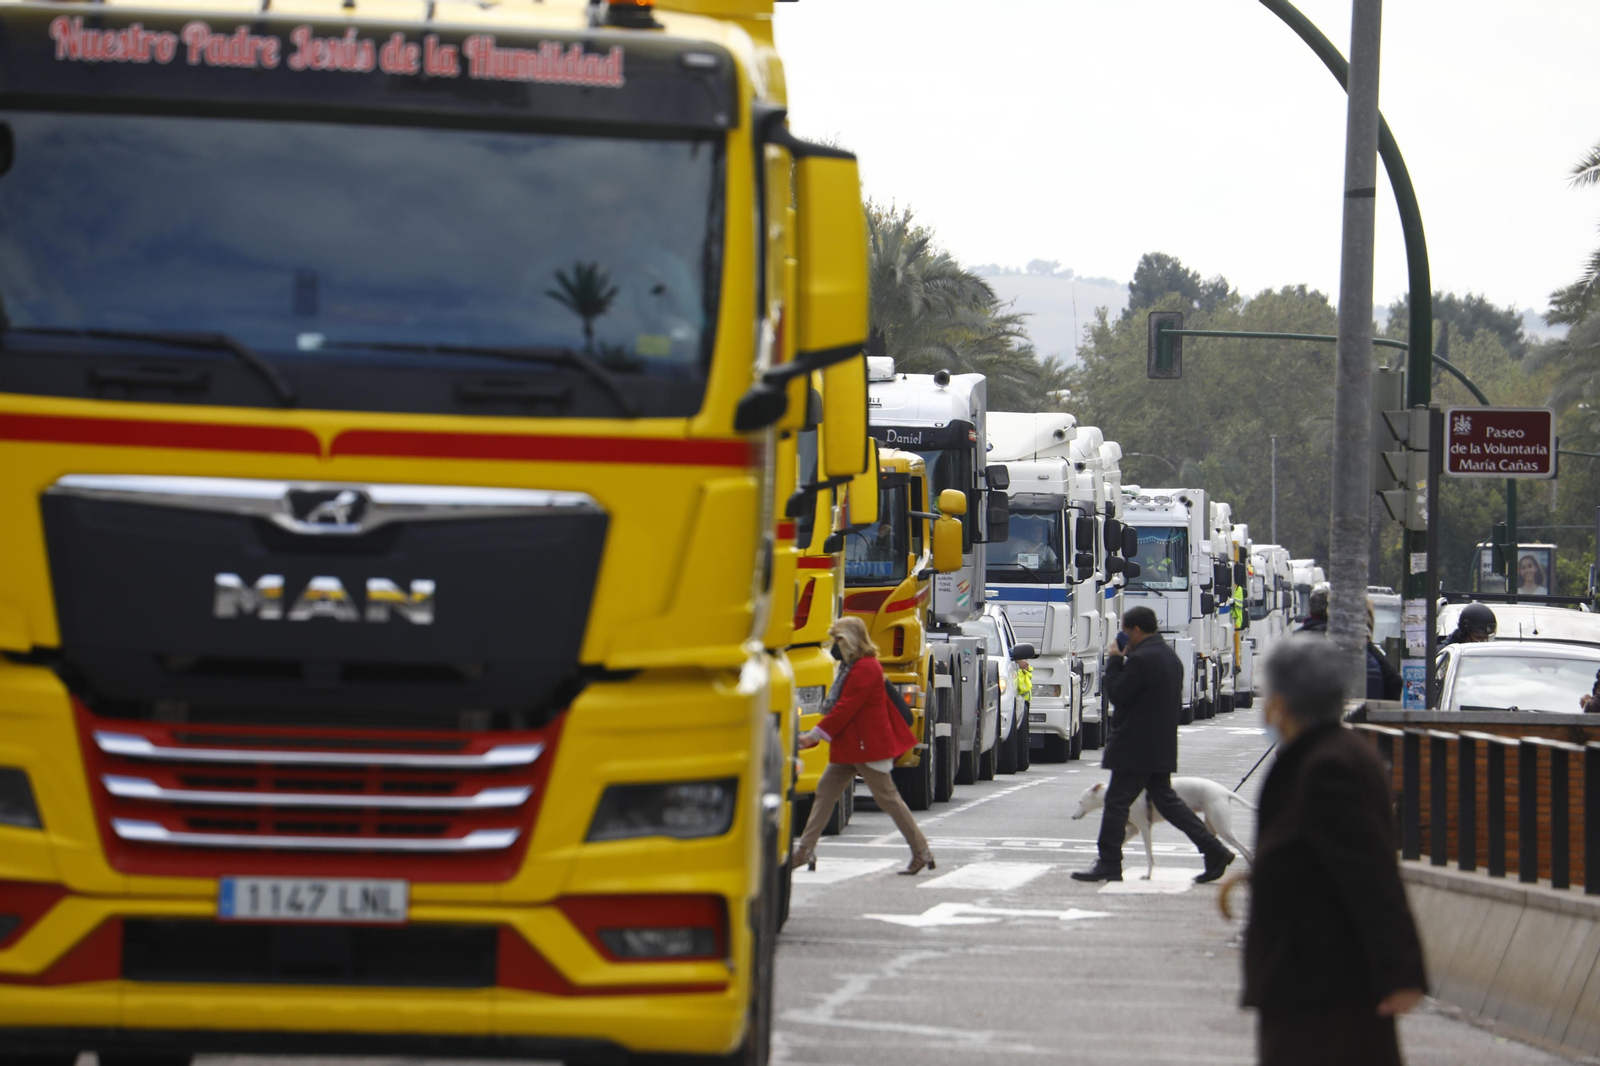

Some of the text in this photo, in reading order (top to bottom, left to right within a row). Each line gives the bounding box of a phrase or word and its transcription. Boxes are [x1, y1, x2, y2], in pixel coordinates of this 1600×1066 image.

[49, 15, 625, 88] Nuestro Padre Jesús de la Humildad
[886, 429, 922, 444] Daniel
[1486, 426, 1525, 438] Paseo
[1450, 442, 1548, 455] de la Voluntaria
[1459, 459, 1539, 471] María Cañas
[213, 573, 436, 625] MAN
[1017, 608, 1044, 616] XF
[248, 882, 400, 917] 1147 LNL
